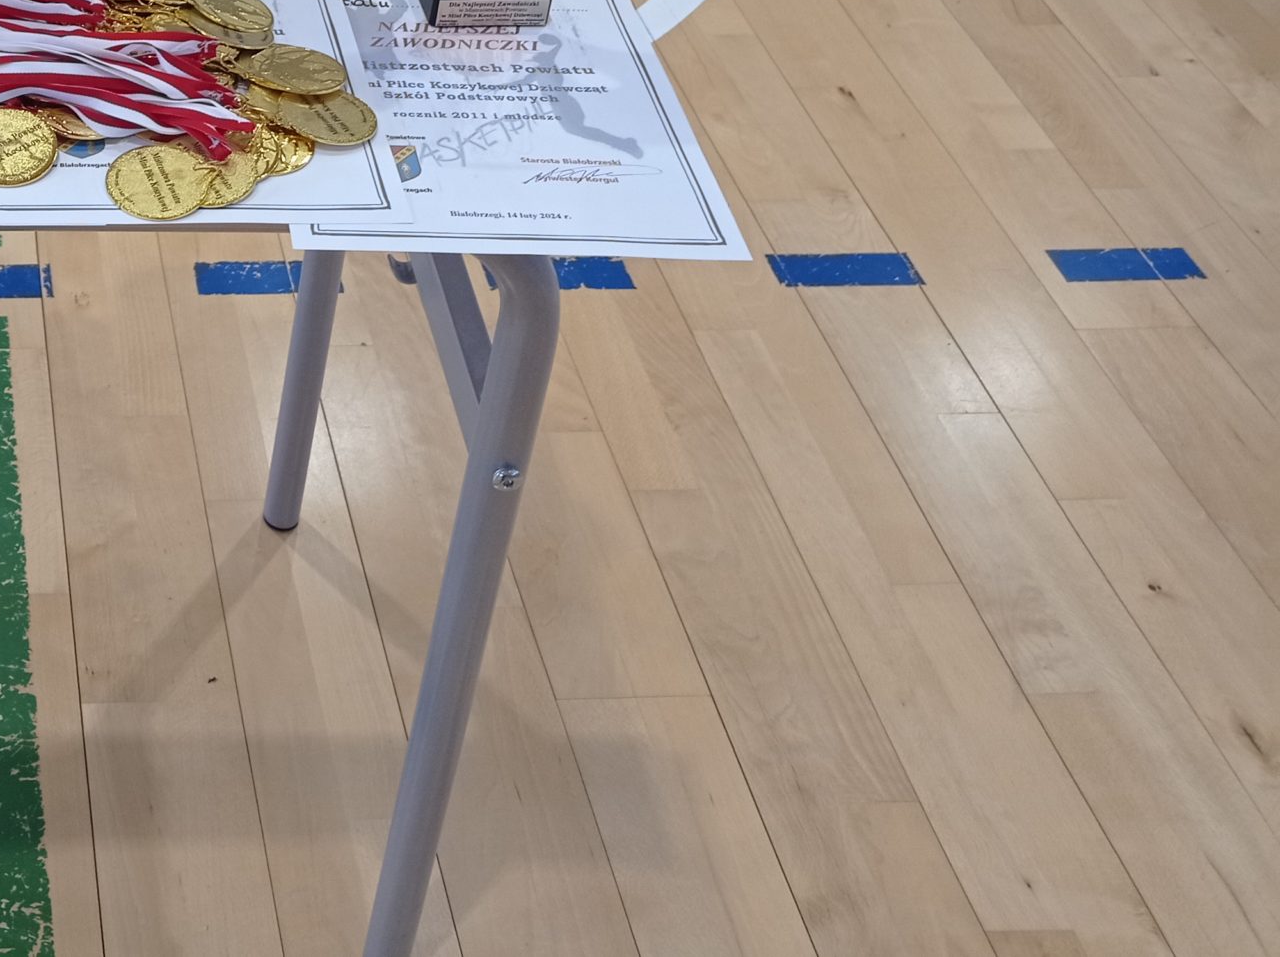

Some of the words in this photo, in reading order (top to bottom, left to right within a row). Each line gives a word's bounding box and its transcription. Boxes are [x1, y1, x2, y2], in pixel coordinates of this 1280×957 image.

[370, 36, 541, 52] ZAWODNICZKI
[510, 64, 595, 75] Powiatu
[430, 81, 524, 93] Koszykowej
[528, 83, 608, 94] Dziewcząt
[436, 92, 560, 104] Podstawowych
[393, 111, 447, 119] rocznik
[451, 111, 488, 120] 2011
[520, 156, 561, 164] Starosta
[519, 212, 538, 220] luty
[539, 212, 562, 220] 2024
